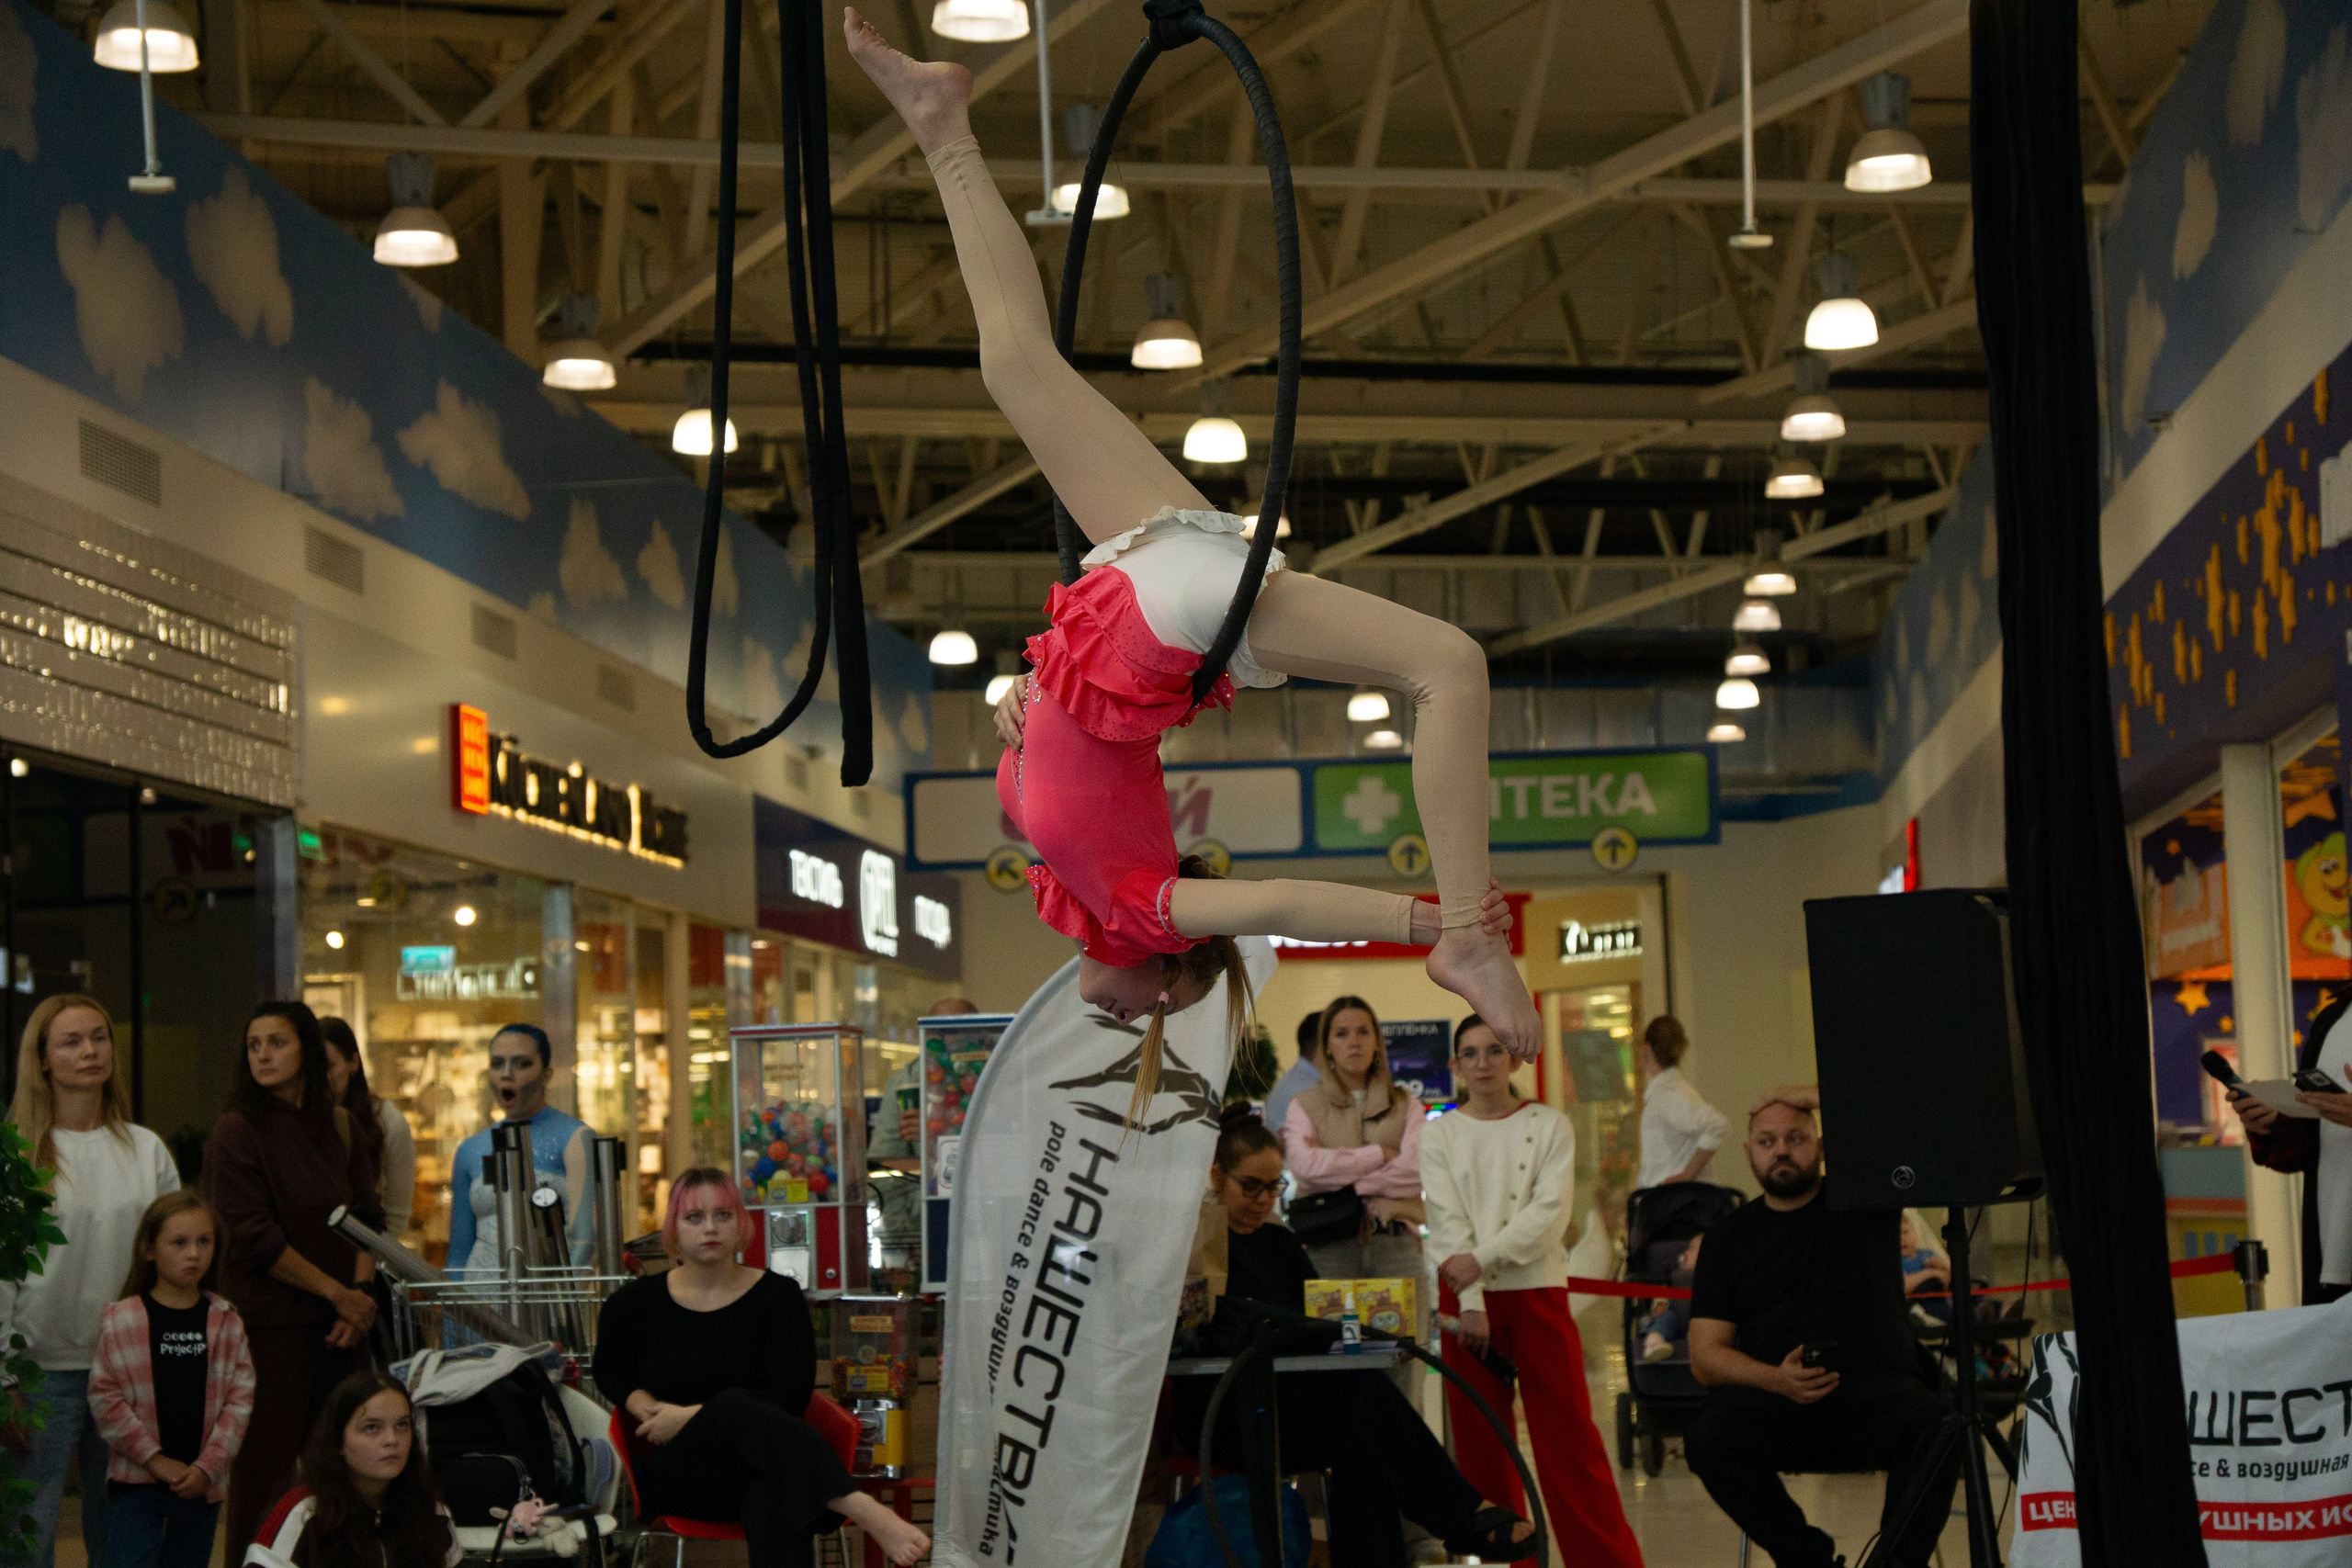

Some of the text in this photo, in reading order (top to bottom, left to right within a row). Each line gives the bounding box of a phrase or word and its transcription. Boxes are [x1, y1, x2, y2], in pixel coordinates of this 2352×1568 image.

[1488, 772, 1657, 819] ТЕКА
[1040, 1121, 1067, 1173] pole
[1018, 1178, 1050, 1247] dance
[1011, 1252, 1029, 1269] &
[988, 1275, 1020, 1407] воздушн
[999, 1138, 1119, 1565] НАШЕСТВ
[2188, 1380, 2352, 1446] ШЕСТ
[2217, 1459, 2231, 1477] &
[2237, 1454, 2350, 1481] воздушная
[2029, 1499, 2076, 1522] ЦЕН
